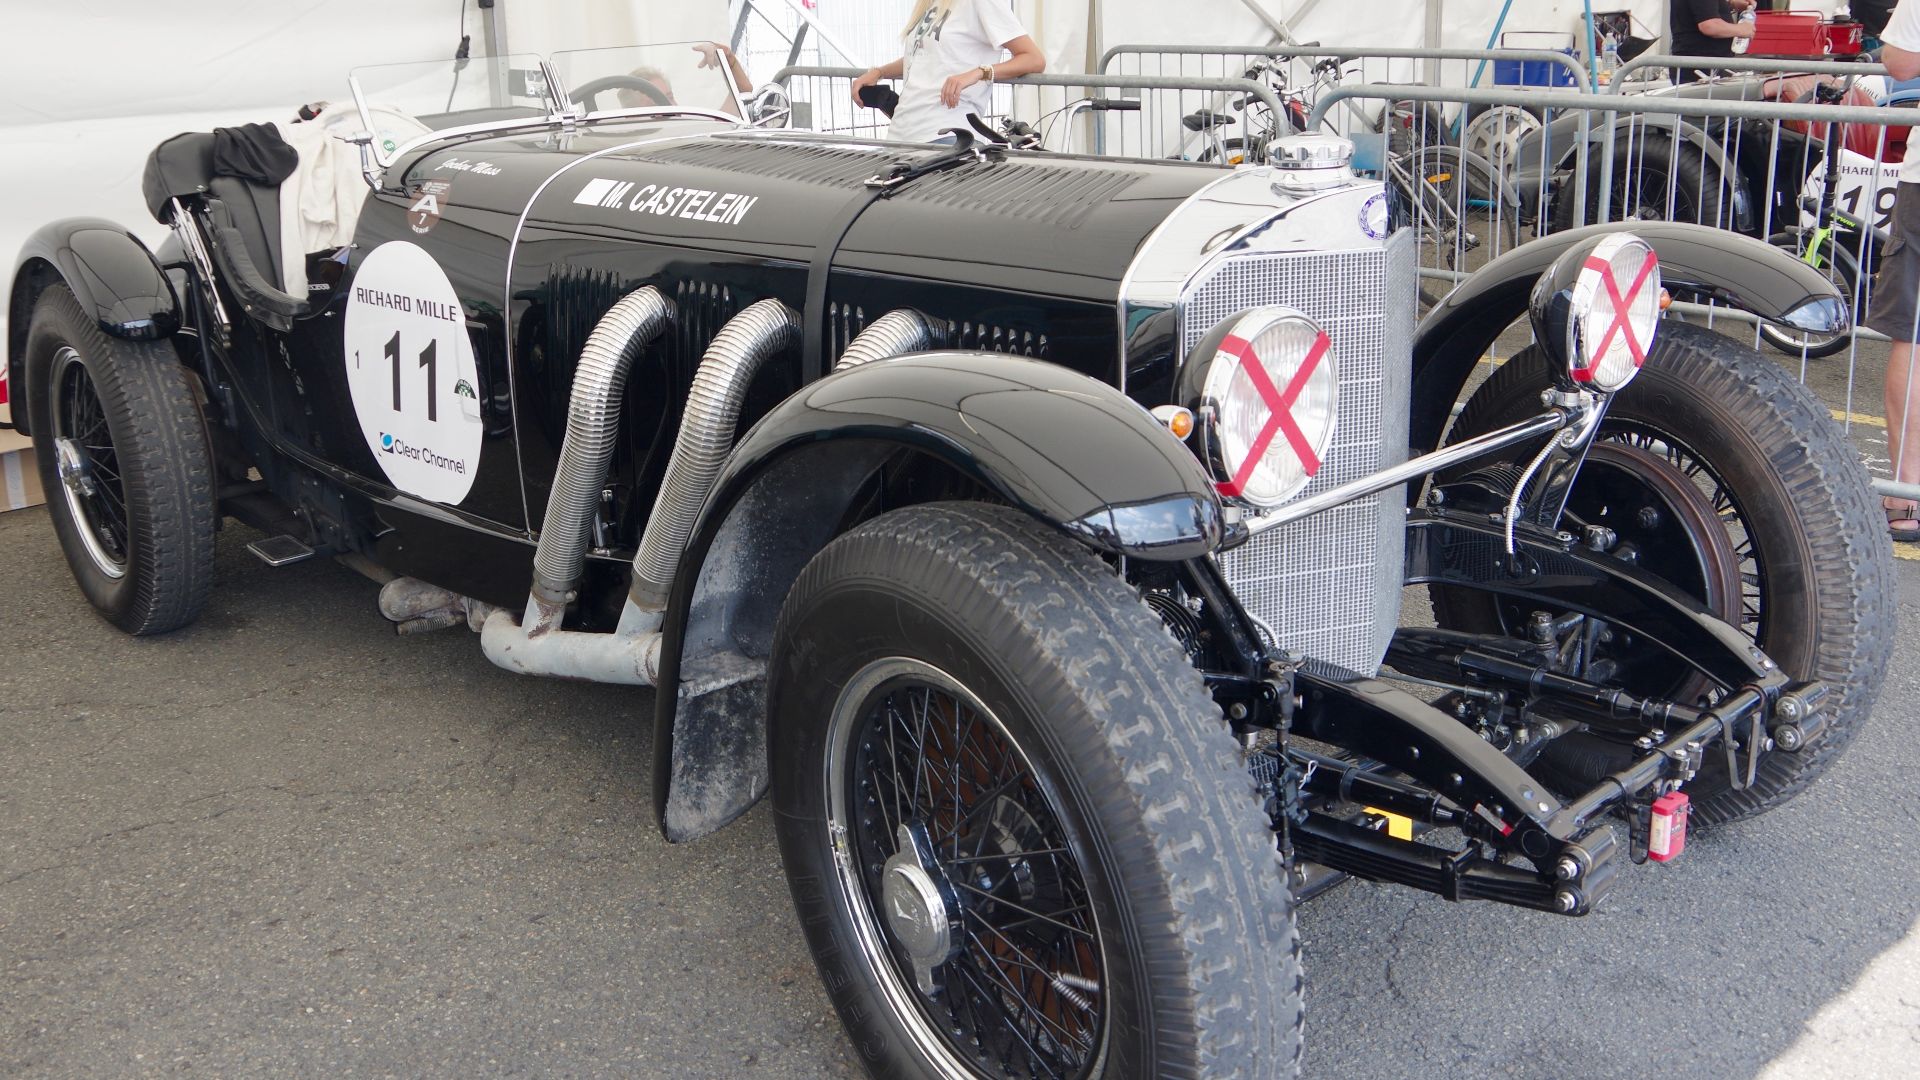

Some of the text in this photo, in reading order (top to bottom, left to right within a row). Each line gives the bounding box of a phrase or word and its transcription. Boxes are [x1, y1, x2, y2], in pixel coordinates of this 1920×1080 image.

[410, 194, 439, 215] A
[419, 213, 427, 225] 7
[600, 181, 759, 225] M. CASTELEIN
[356, 287, 457, 322] RICHARD MILLE
[354, 330, 437, 422] 1 11
[394, 438, 466, 475] Clear Channel
